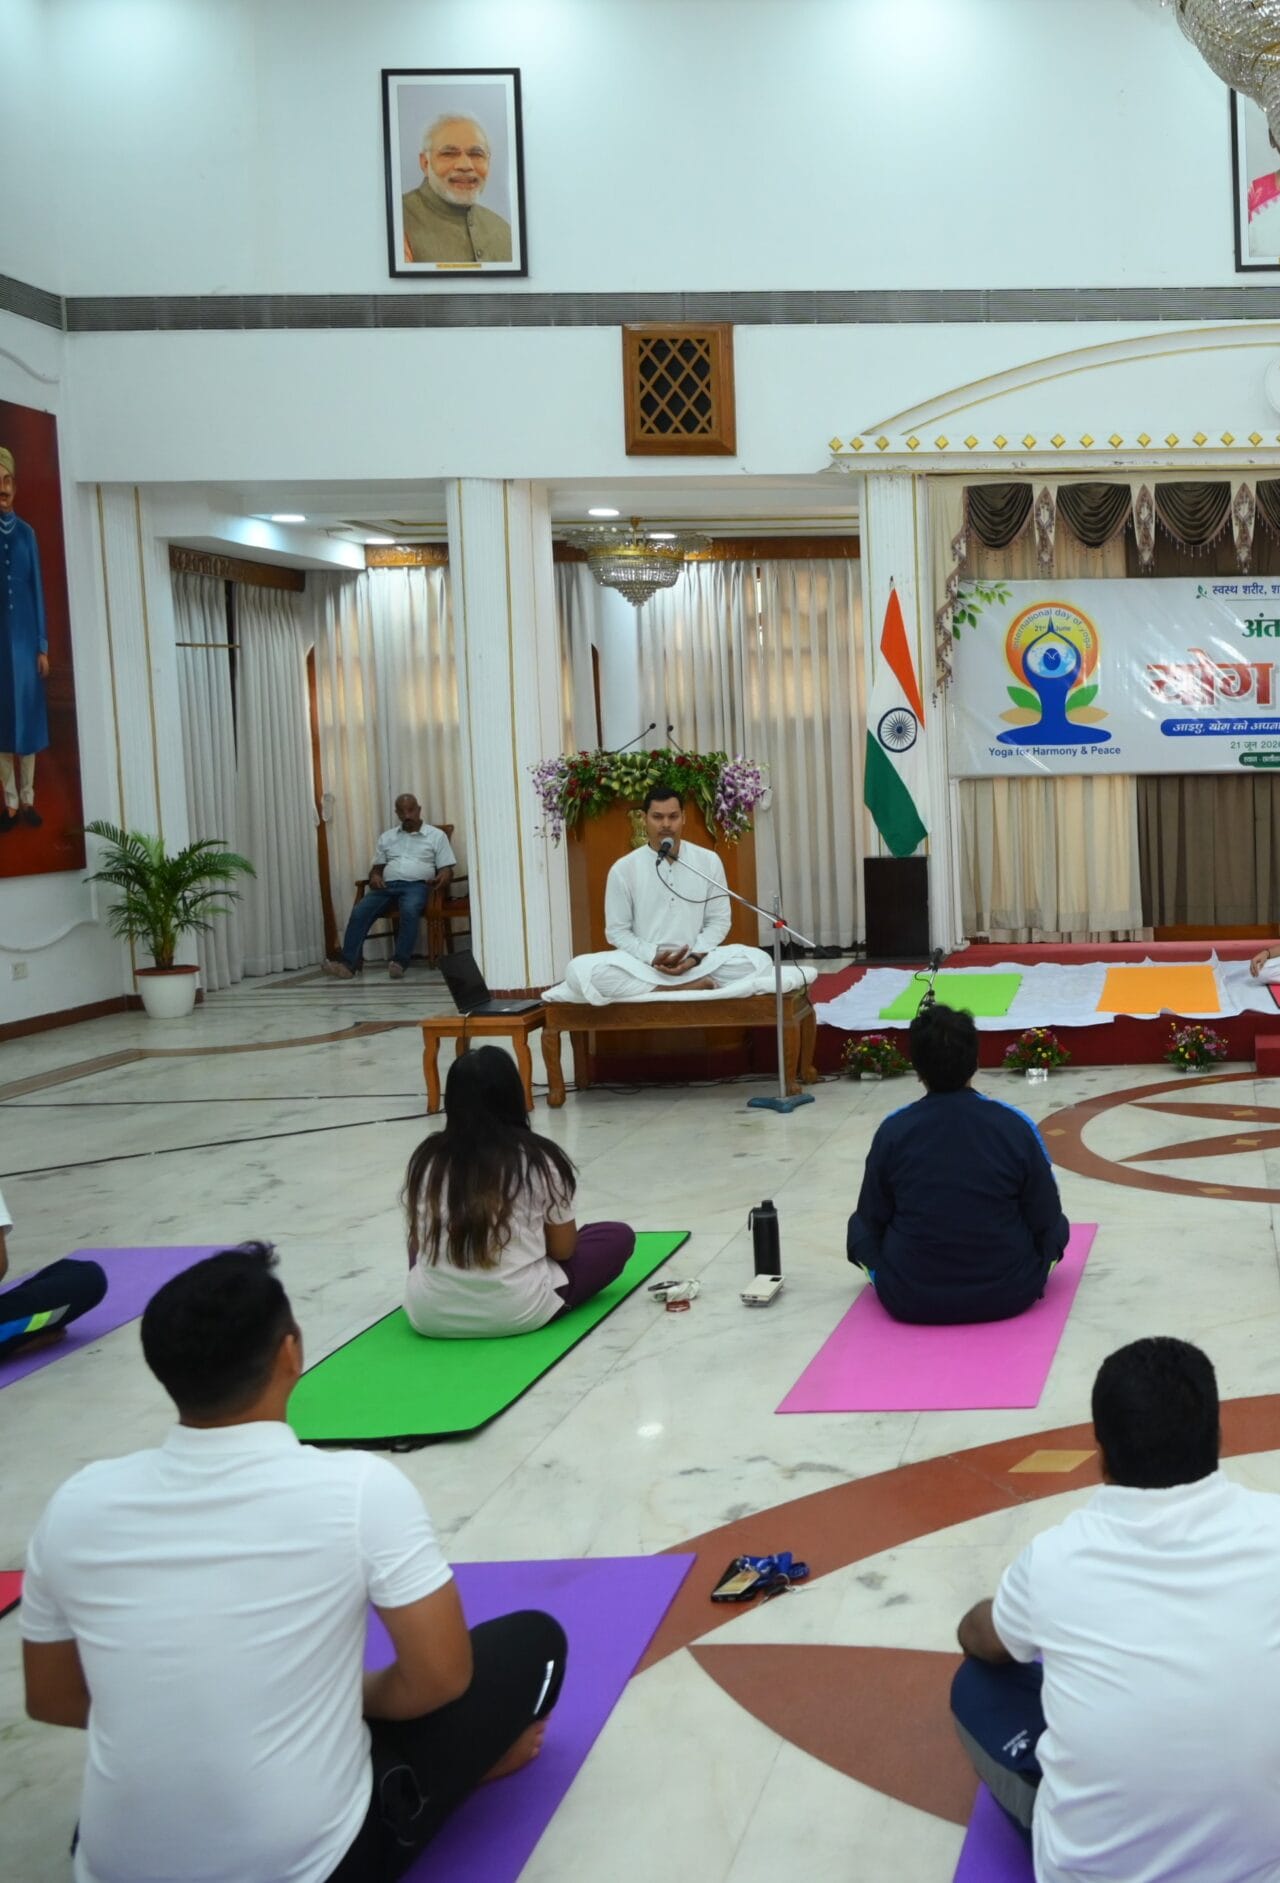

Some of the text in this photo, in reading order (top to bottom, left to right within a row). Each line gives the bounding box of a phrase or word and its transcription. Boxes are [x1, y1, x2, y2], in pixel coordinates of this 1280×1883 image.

[1212, 584, 1238, 595] स्वस्थ
[1242, 583, 1267, 595] शरीर,
[1055, 608, 1073, 621] day
[1146, 647, 1274, 705] योग
[1232, 720, 1249, 730] को
[989, 748, 1013, 758] Yoga
[1032, 746, 1078, 757] Harmony
[1080, 746, 1088, 754] &
[1091, 746, 1121, 755] Peace
[1244, 741, 1258, 752] जून
